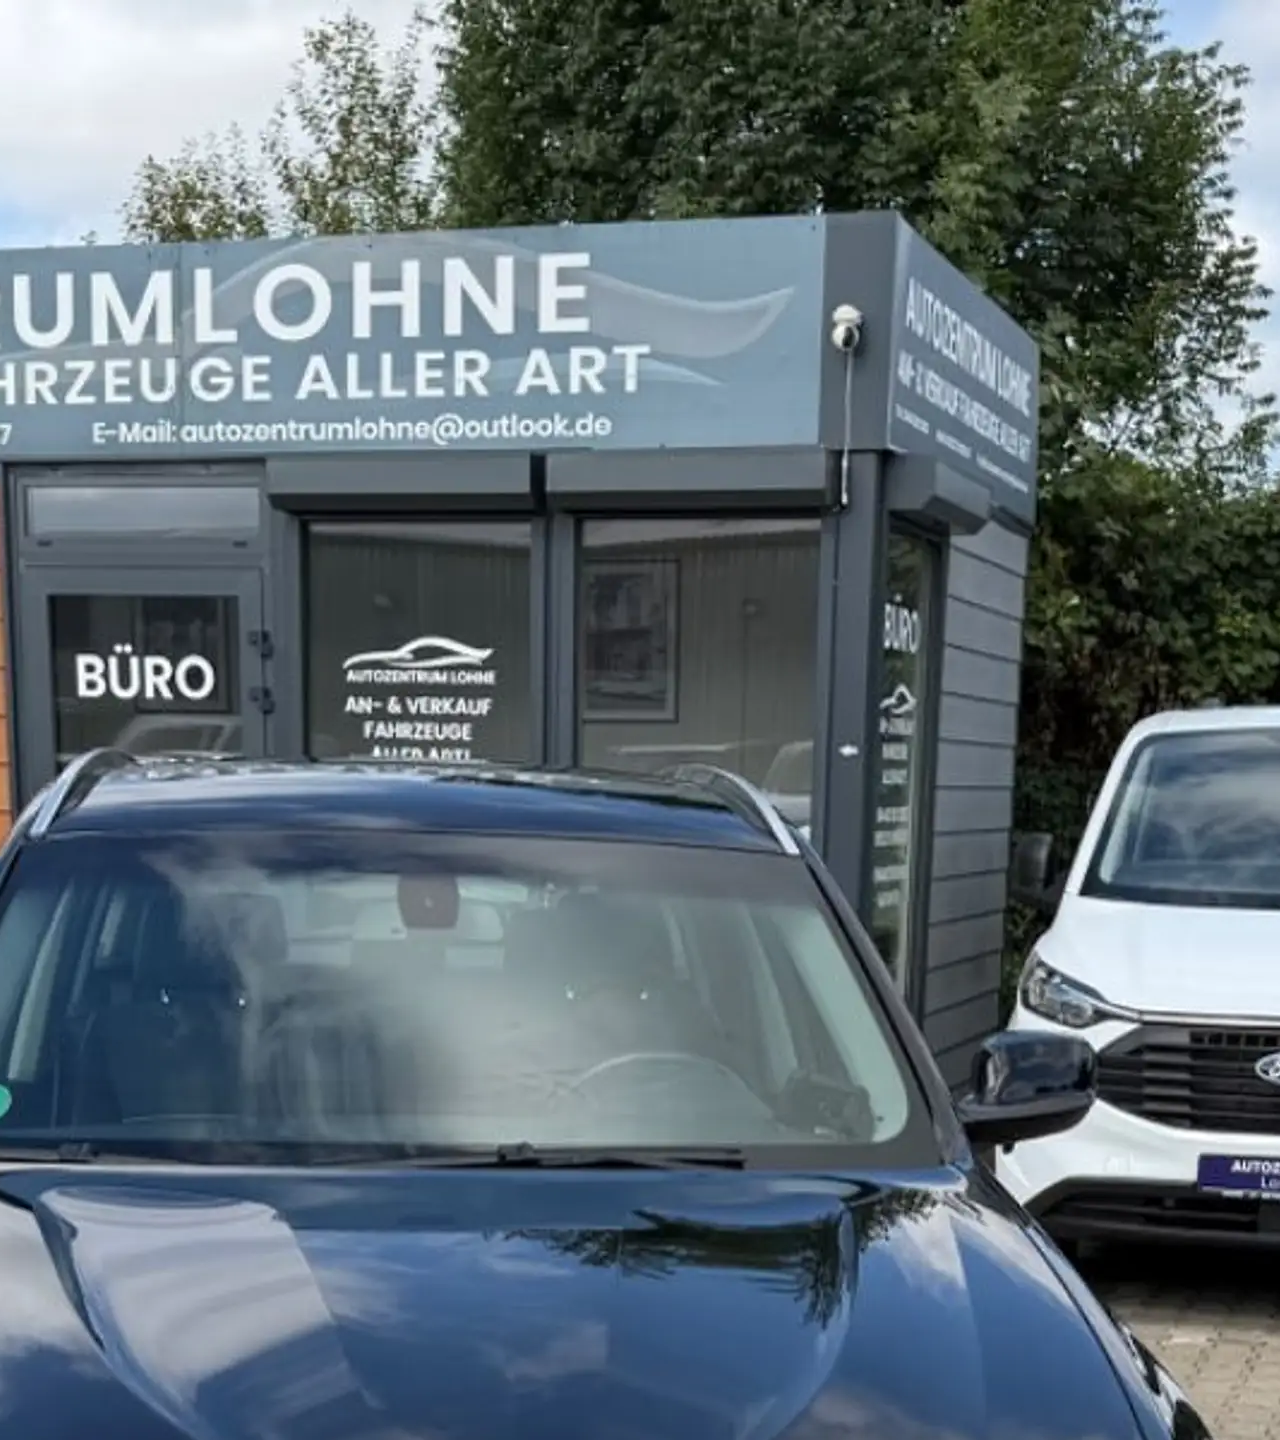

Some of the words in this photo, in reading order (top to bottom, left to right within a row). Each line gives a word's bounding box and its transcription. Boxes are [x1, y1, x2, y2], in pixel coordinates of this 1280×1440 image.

[295, 348, 490, 401] ALLER
[516, 344, 650, 396] ART
[92, 418, 176, 444] E-Mail:
[179, 412, 613, 446] autozentrumlohne@outlook.de
[75, 643, 215, 700] BÜRO
[345, 695, 383, 714] AN-
[387, 695, 402, 714] &
[405, 696, 493, 716] VERKAUF
[363, 720, 472, 741] FAHRZEUGE
